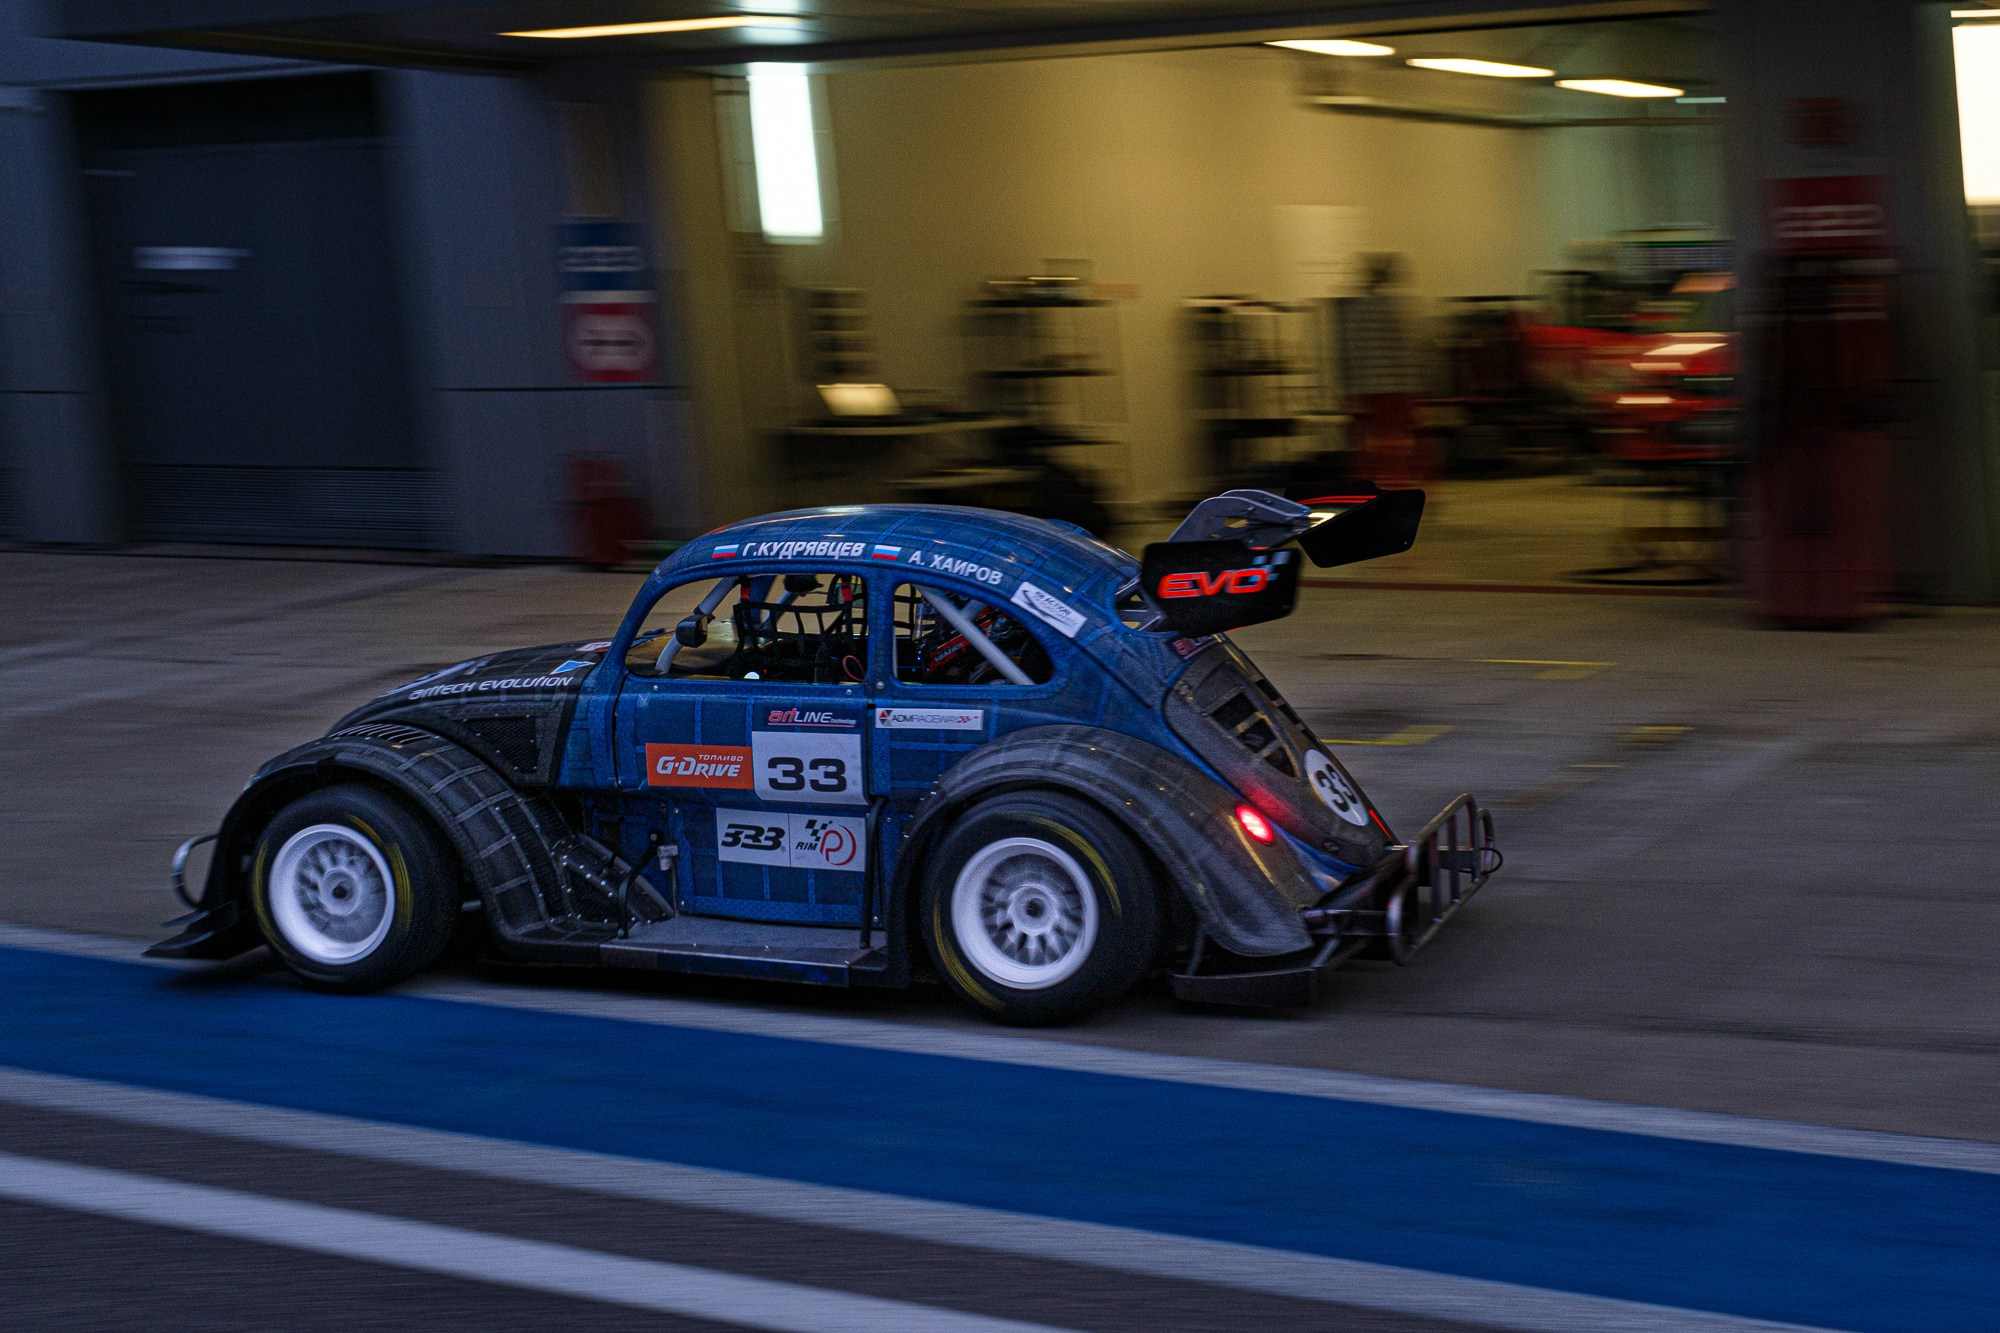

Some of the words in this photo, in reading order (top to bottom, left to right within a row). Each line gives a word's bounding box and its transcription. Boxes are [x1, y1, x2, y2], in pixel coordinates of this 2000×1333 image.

[1157, 568, 1269, 598] EVO
[768, 757, 847, 793] 33
[1316, 764, 1357, 812] 33
[796, 842, 818, 851] RIM
